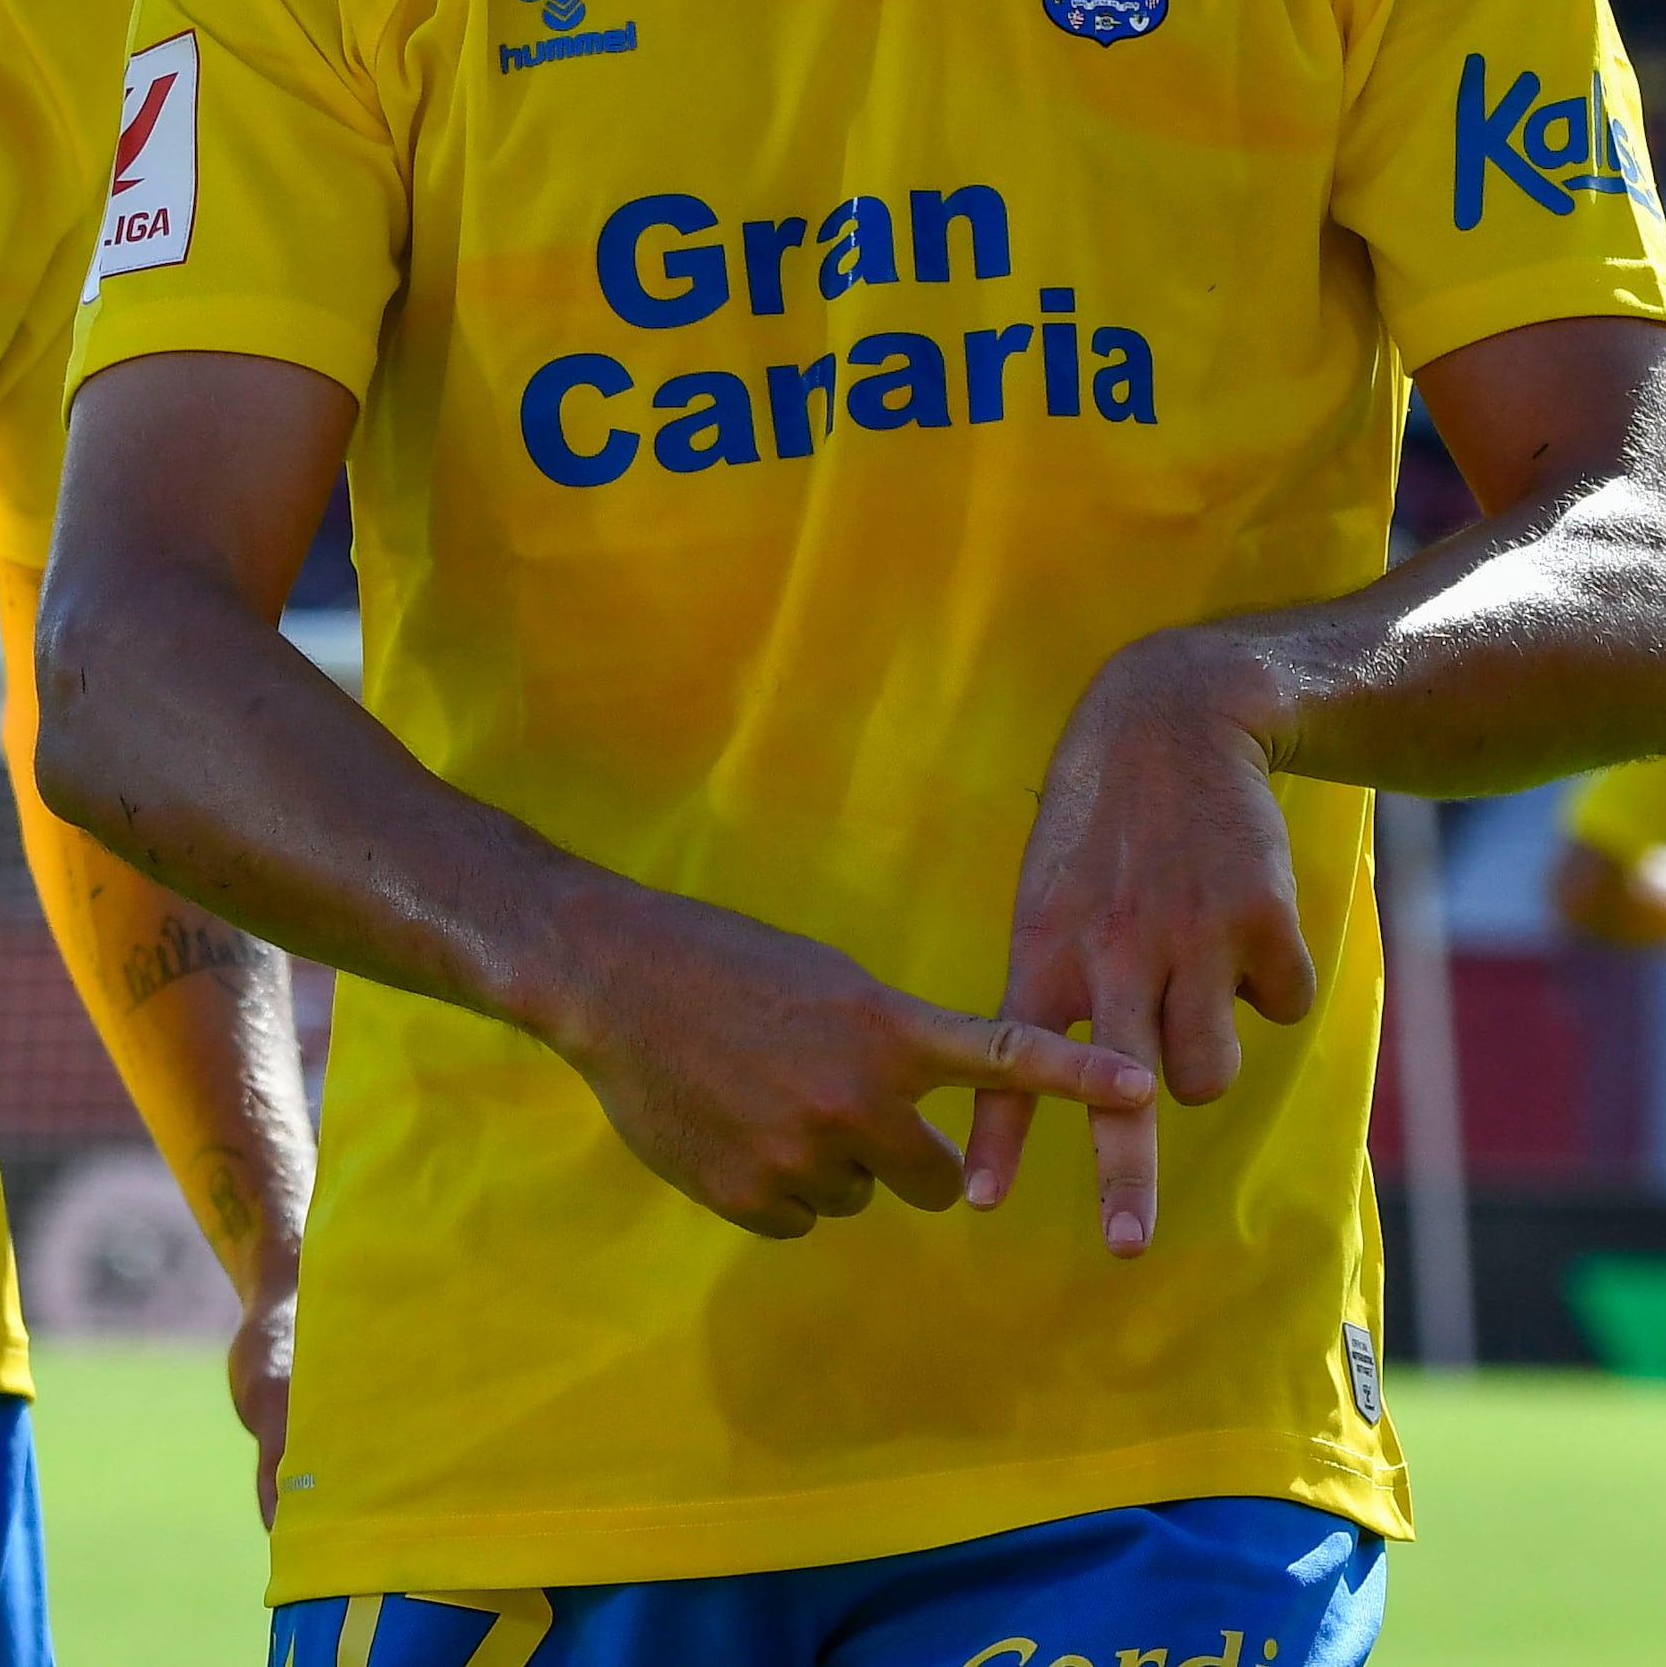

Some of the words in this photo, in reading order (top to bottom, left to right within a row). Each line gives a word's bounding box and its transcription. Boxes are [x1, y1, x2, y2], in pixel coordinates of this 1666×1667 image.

[500, 20, 638, 74] hummel
[103, 206, 171, 247] IGA
[596, 184, 1011, 329] Gran
[520, 287, 1159, 488] Canaria
